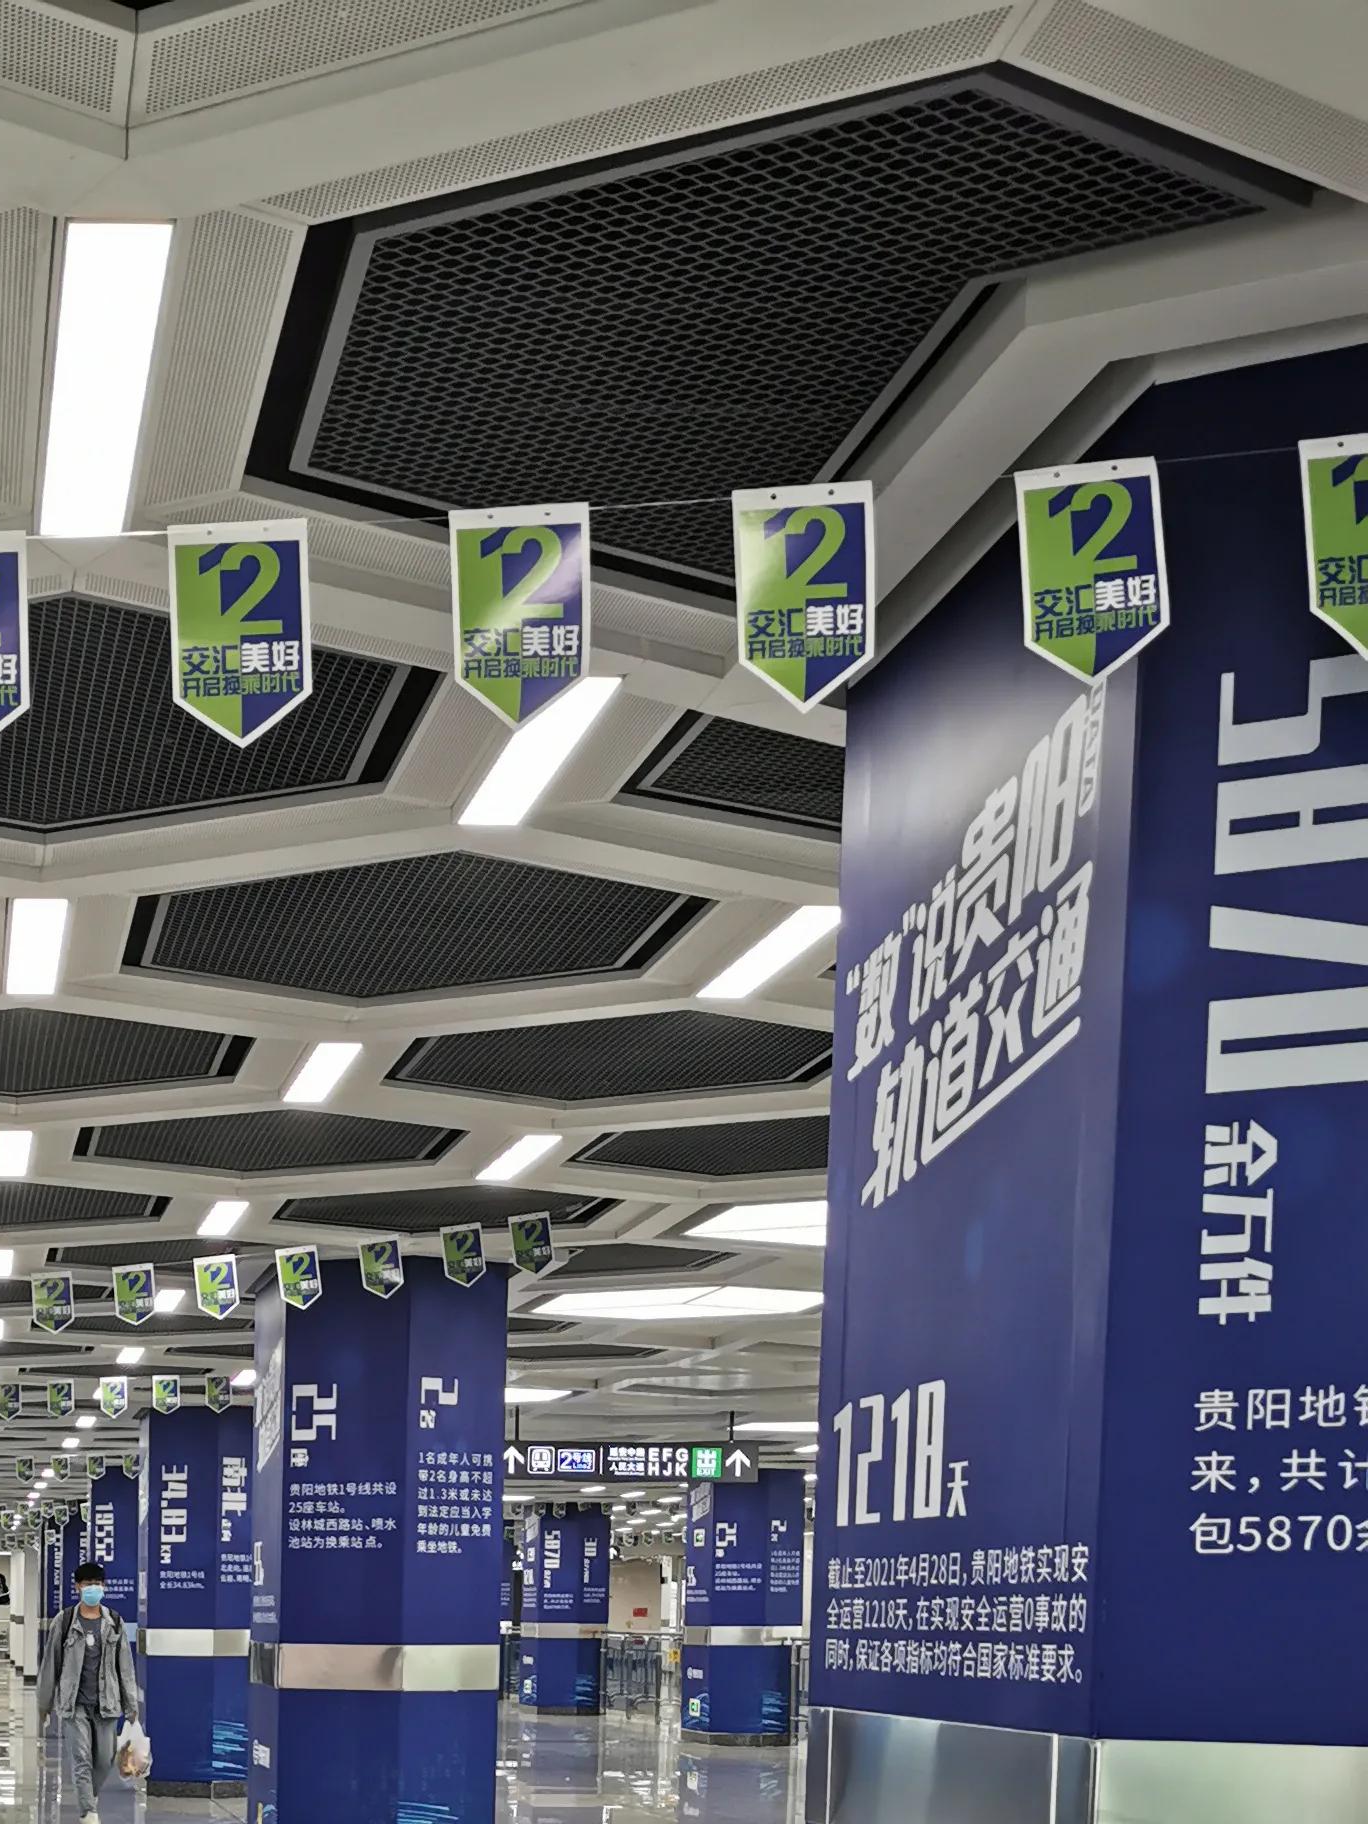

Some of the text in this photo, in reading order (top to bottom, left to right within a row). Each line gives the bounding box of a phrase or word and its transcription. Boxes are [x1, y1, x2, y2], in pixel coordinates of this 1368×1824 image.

[1033, 574, 1156, 619] 交汇美好
[748, 604, 863, 637] 交汇美好
[1034, 607, 1158, 642] 开启换乘时代
[464, 625, 579, 657] 交汇美好
[748, 635, 862, 659] 开启换乘时代
[181, 641, 299, 675] 交汇美好
[464, 657, 578, 679] 开启换乘时代
[182, 673, 299, 698] 开启换乘时代
[861, 860, 1093, 1209] 轨道交通
[289, 1482, 397, 1496] 贵阳地铁1号线共设
[1189, 1512, 1368, 1554] 包5870
